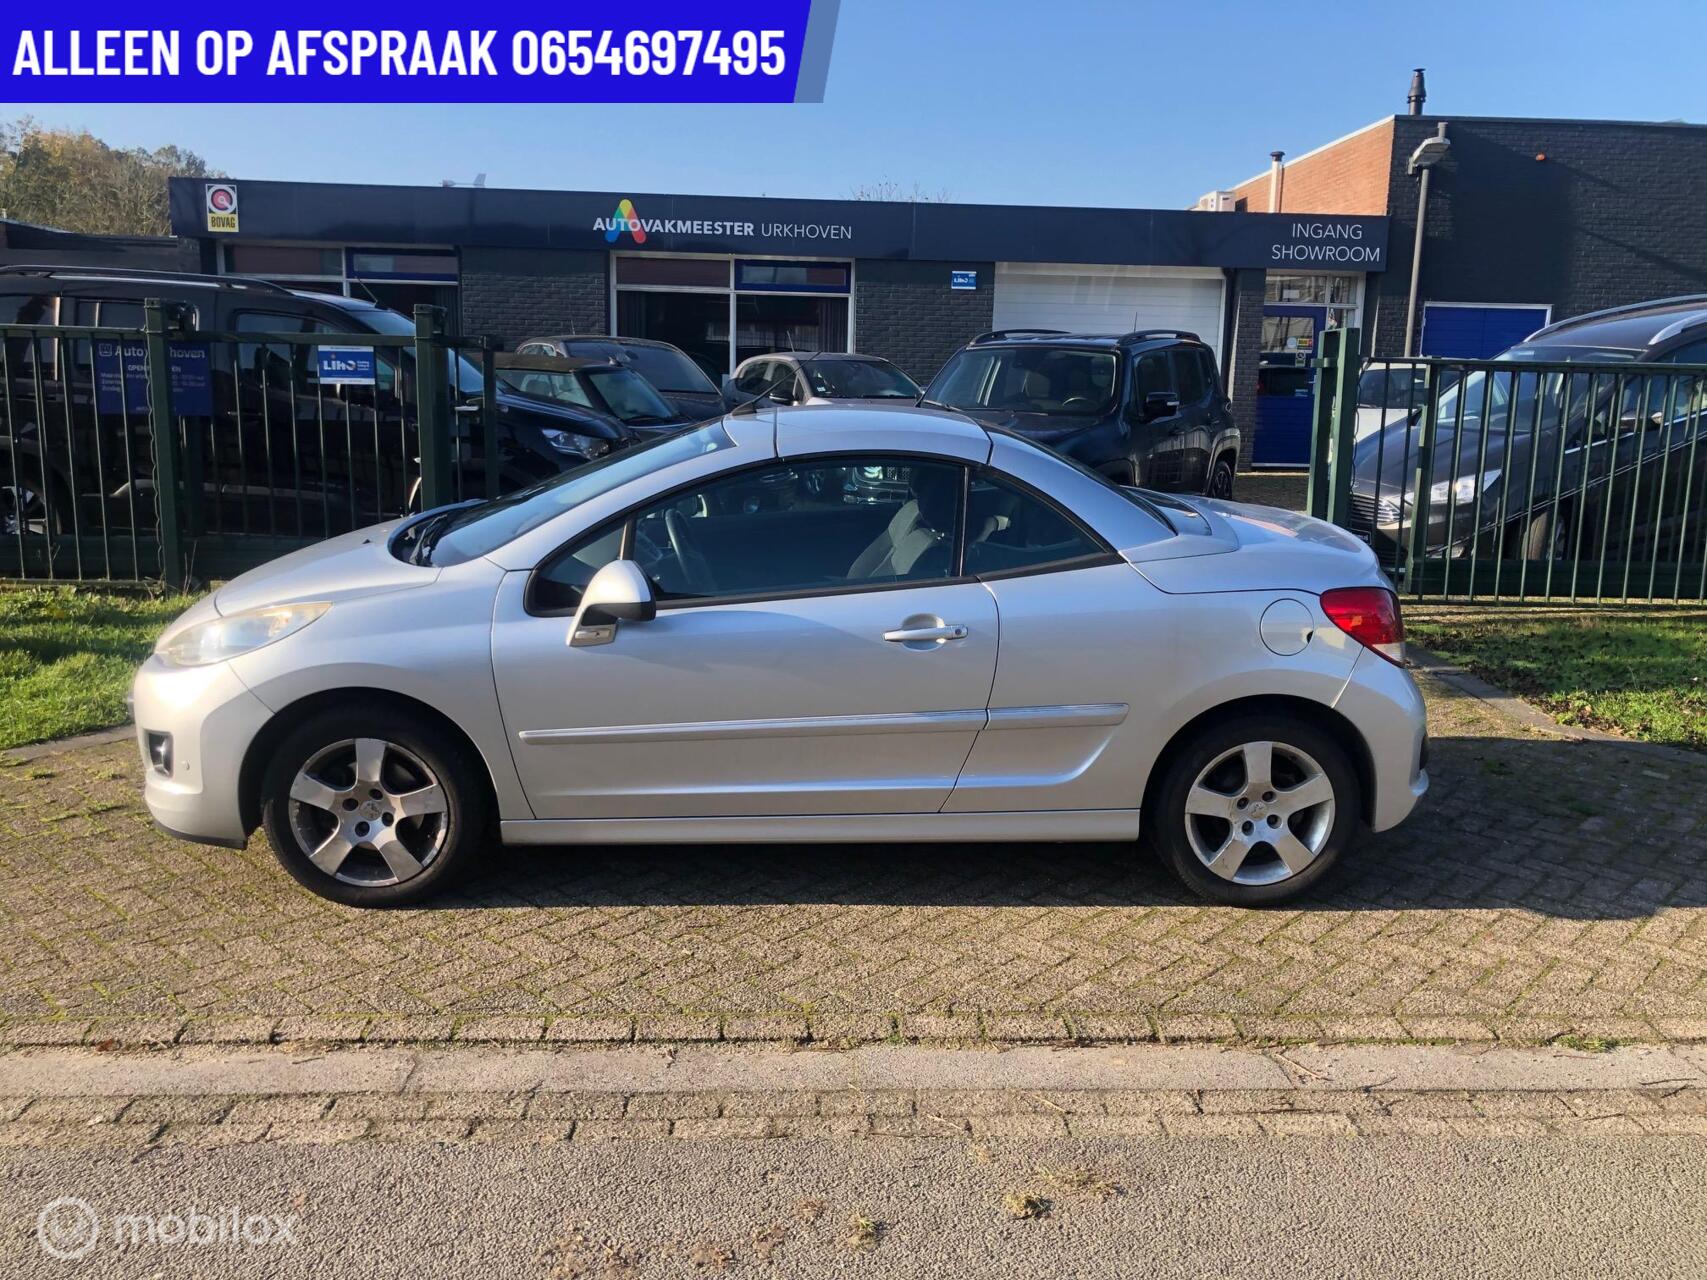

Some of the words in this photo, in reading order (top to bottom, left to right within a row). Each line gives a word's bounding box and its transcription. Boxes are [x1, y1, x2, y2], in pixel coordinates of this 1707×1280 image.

[211, 216, 236, 228] BOVAG
[593, 217, 754, 236] AUTOVAKMEESTER
[761, 223, 852, 239] URKHOVEN
[1292, 223, 1362, 239] INGANG
[1271, 244, 1380, 262] SHOWROOM
